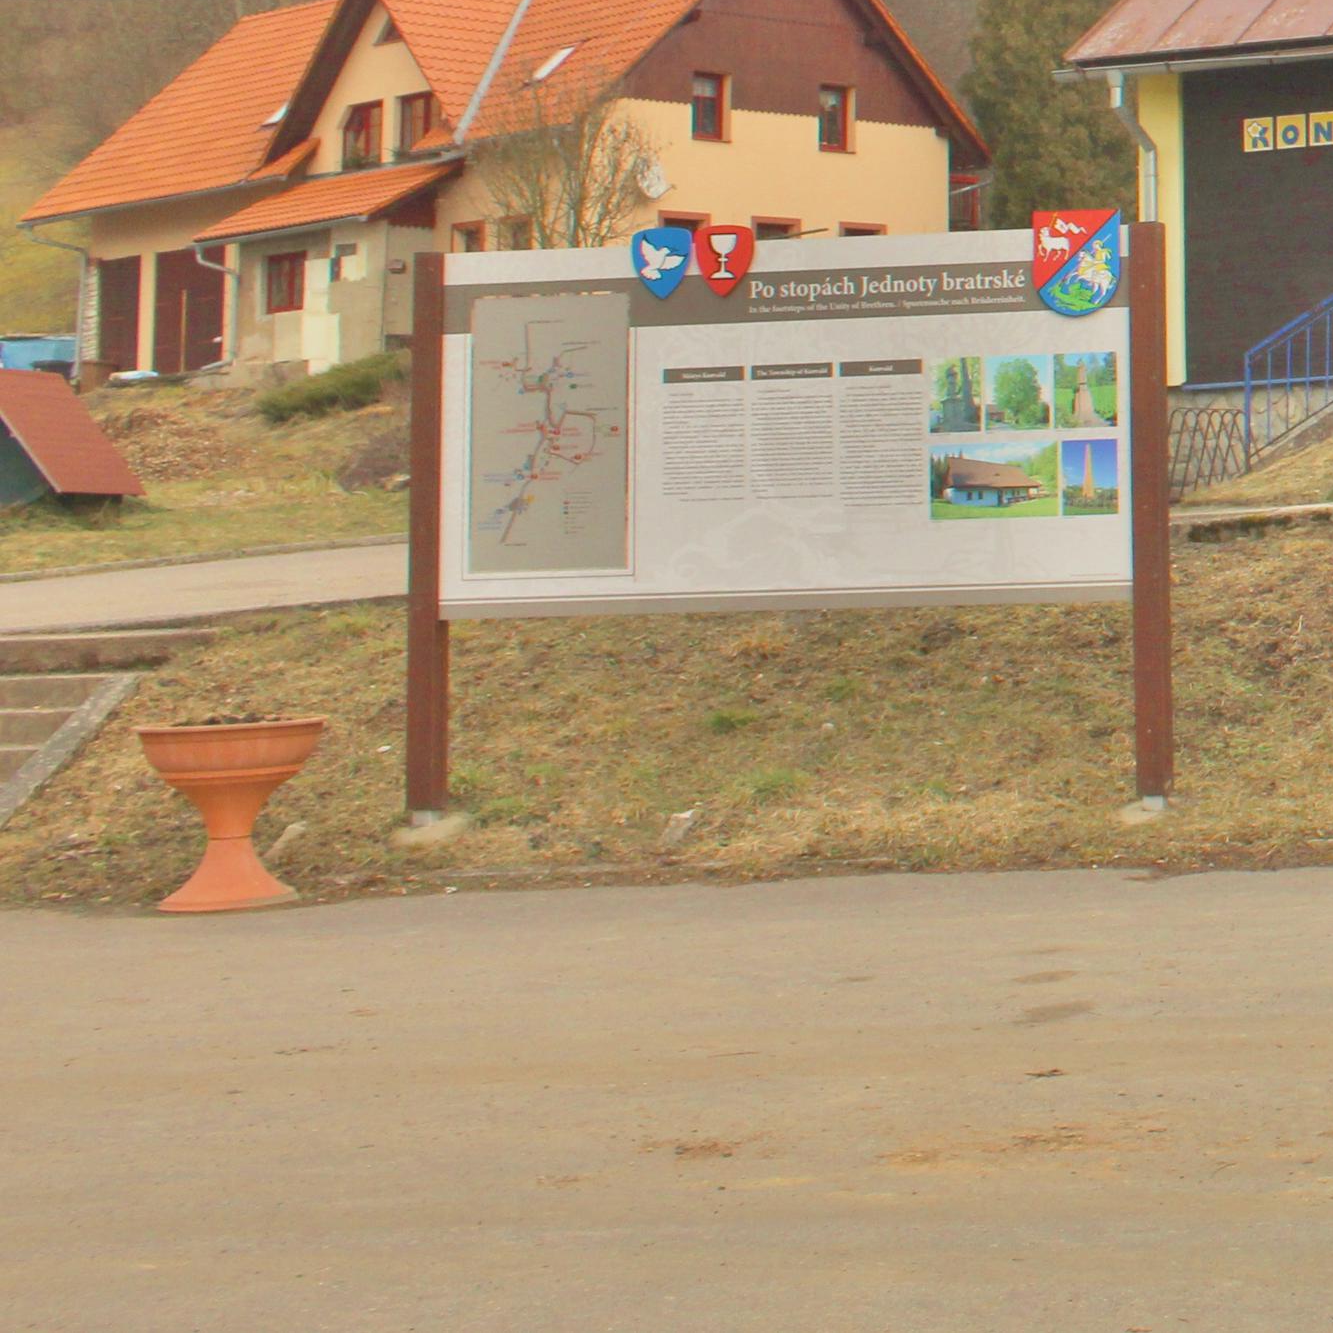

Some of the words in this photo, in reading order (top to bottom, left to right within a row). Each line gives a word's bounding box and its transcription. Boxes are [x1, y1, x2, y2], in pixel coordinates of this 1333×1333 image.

[749, 280, 775, 300] Po
[780, 275, 856, 302] stopách
[861, 274, 938, 298] Jednoty
[942, 268, 1026, 291] bratrské
